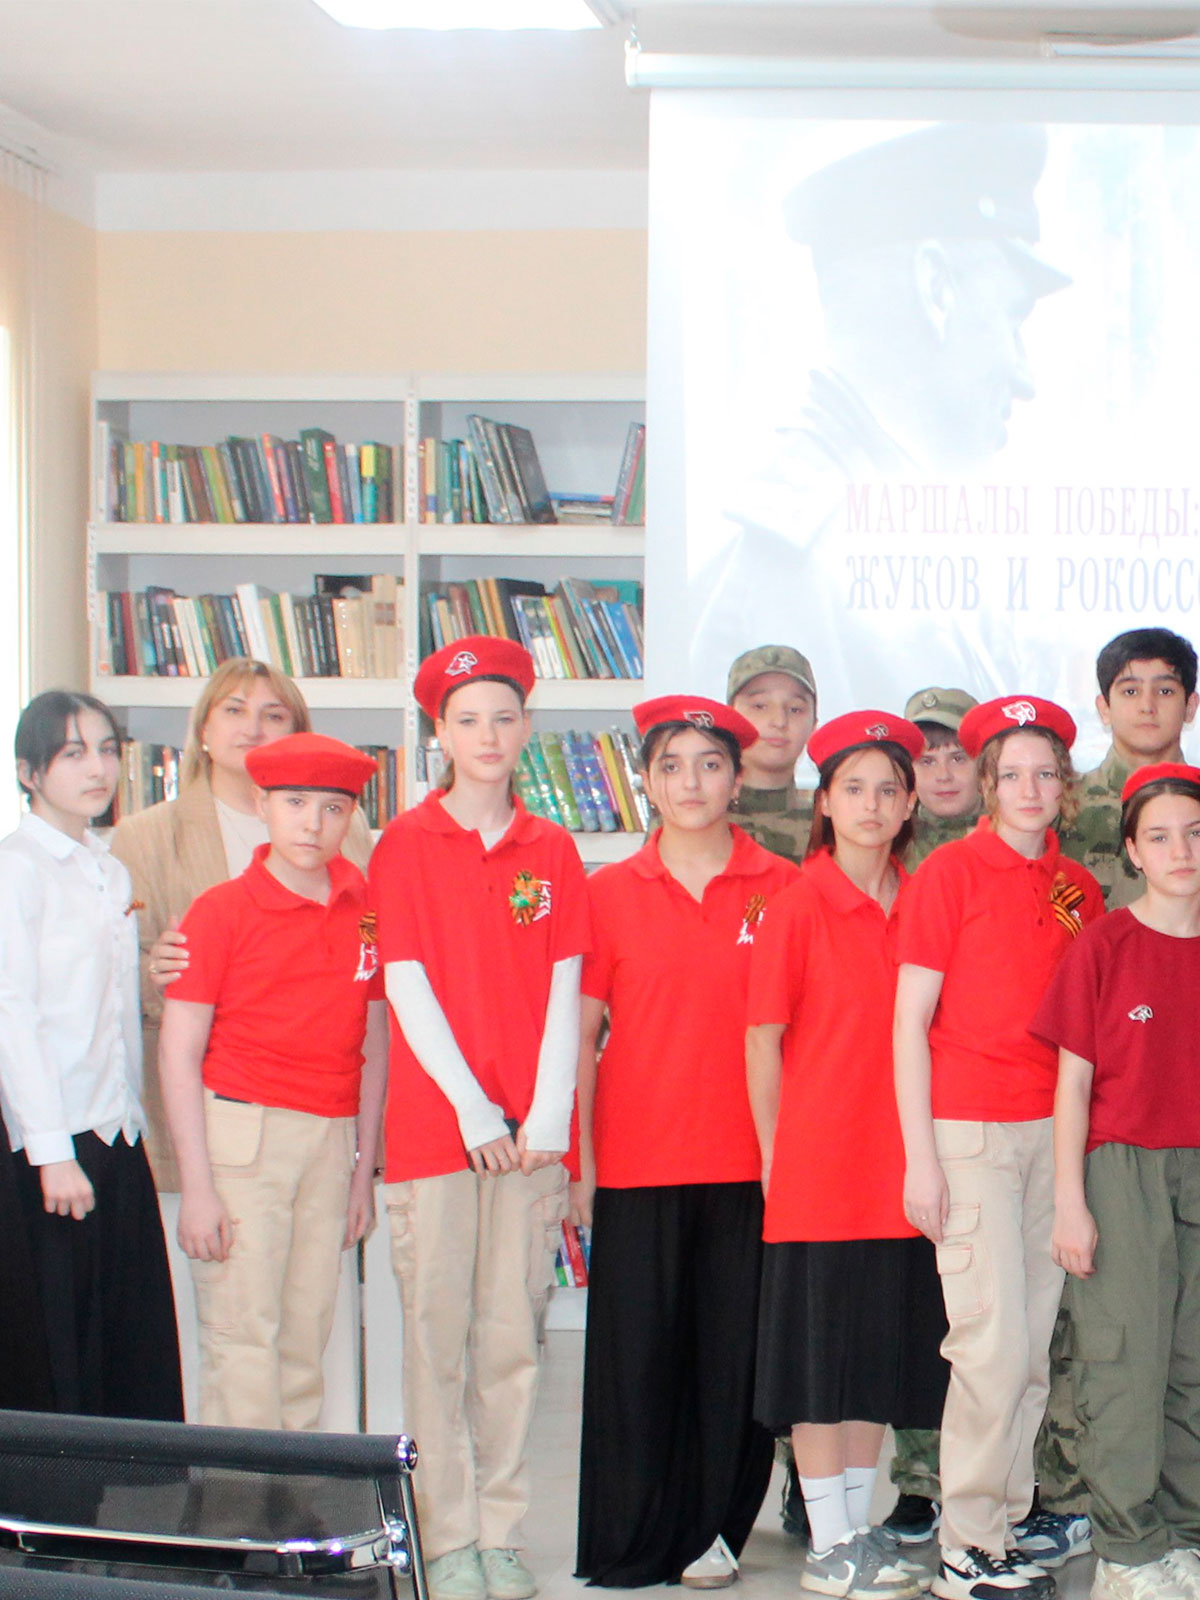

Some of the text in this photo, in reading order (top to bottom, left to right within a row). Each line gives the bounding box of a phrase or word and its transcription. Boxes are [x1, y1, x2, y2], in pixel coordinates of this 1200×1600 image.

[846, 484, 1199, 548] МАРШАЛЫ ПОБЕДЫ:
[846, 556, 981, 611] ЖУКОВ
[1006, 557, 1030, 611] И
